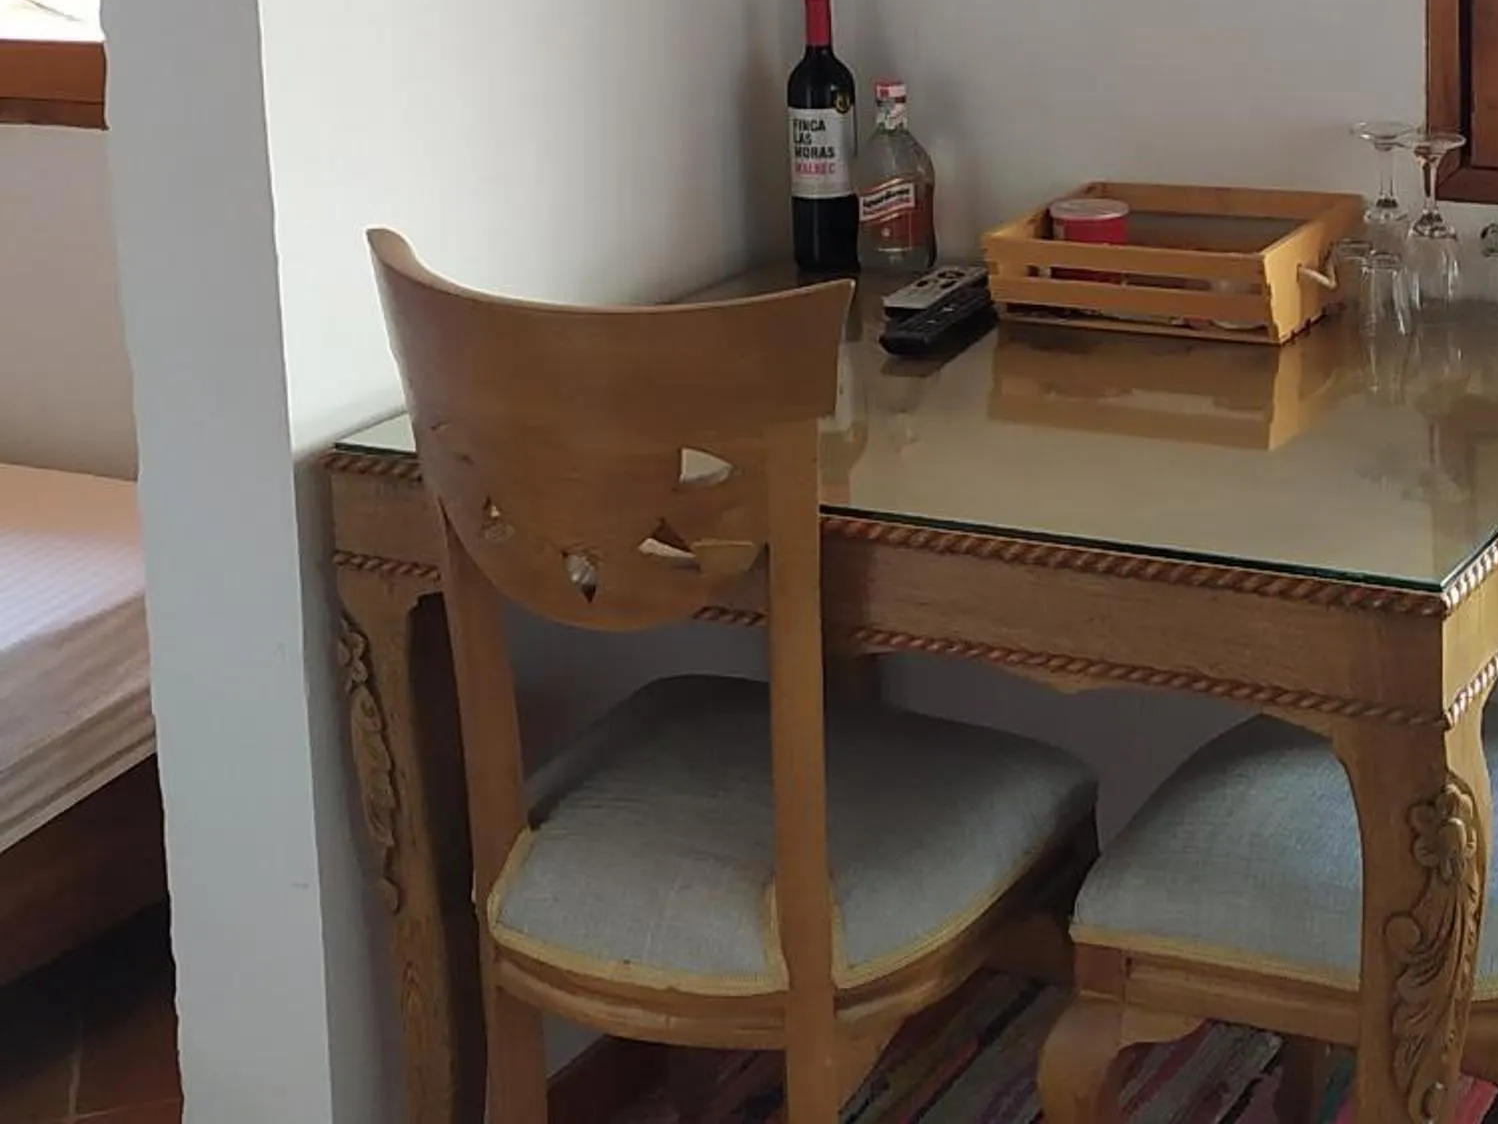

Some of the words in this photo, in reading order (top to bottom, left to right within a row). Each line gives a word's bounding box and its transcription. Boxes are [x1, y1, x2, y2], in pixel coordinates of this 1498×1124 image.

[793, 119, 826, 132] FINCA
[793, 132, 812, 145] LAS
[794, 146, 835, 158] MORAS
[795, 162, 836, 174] MALBEC
